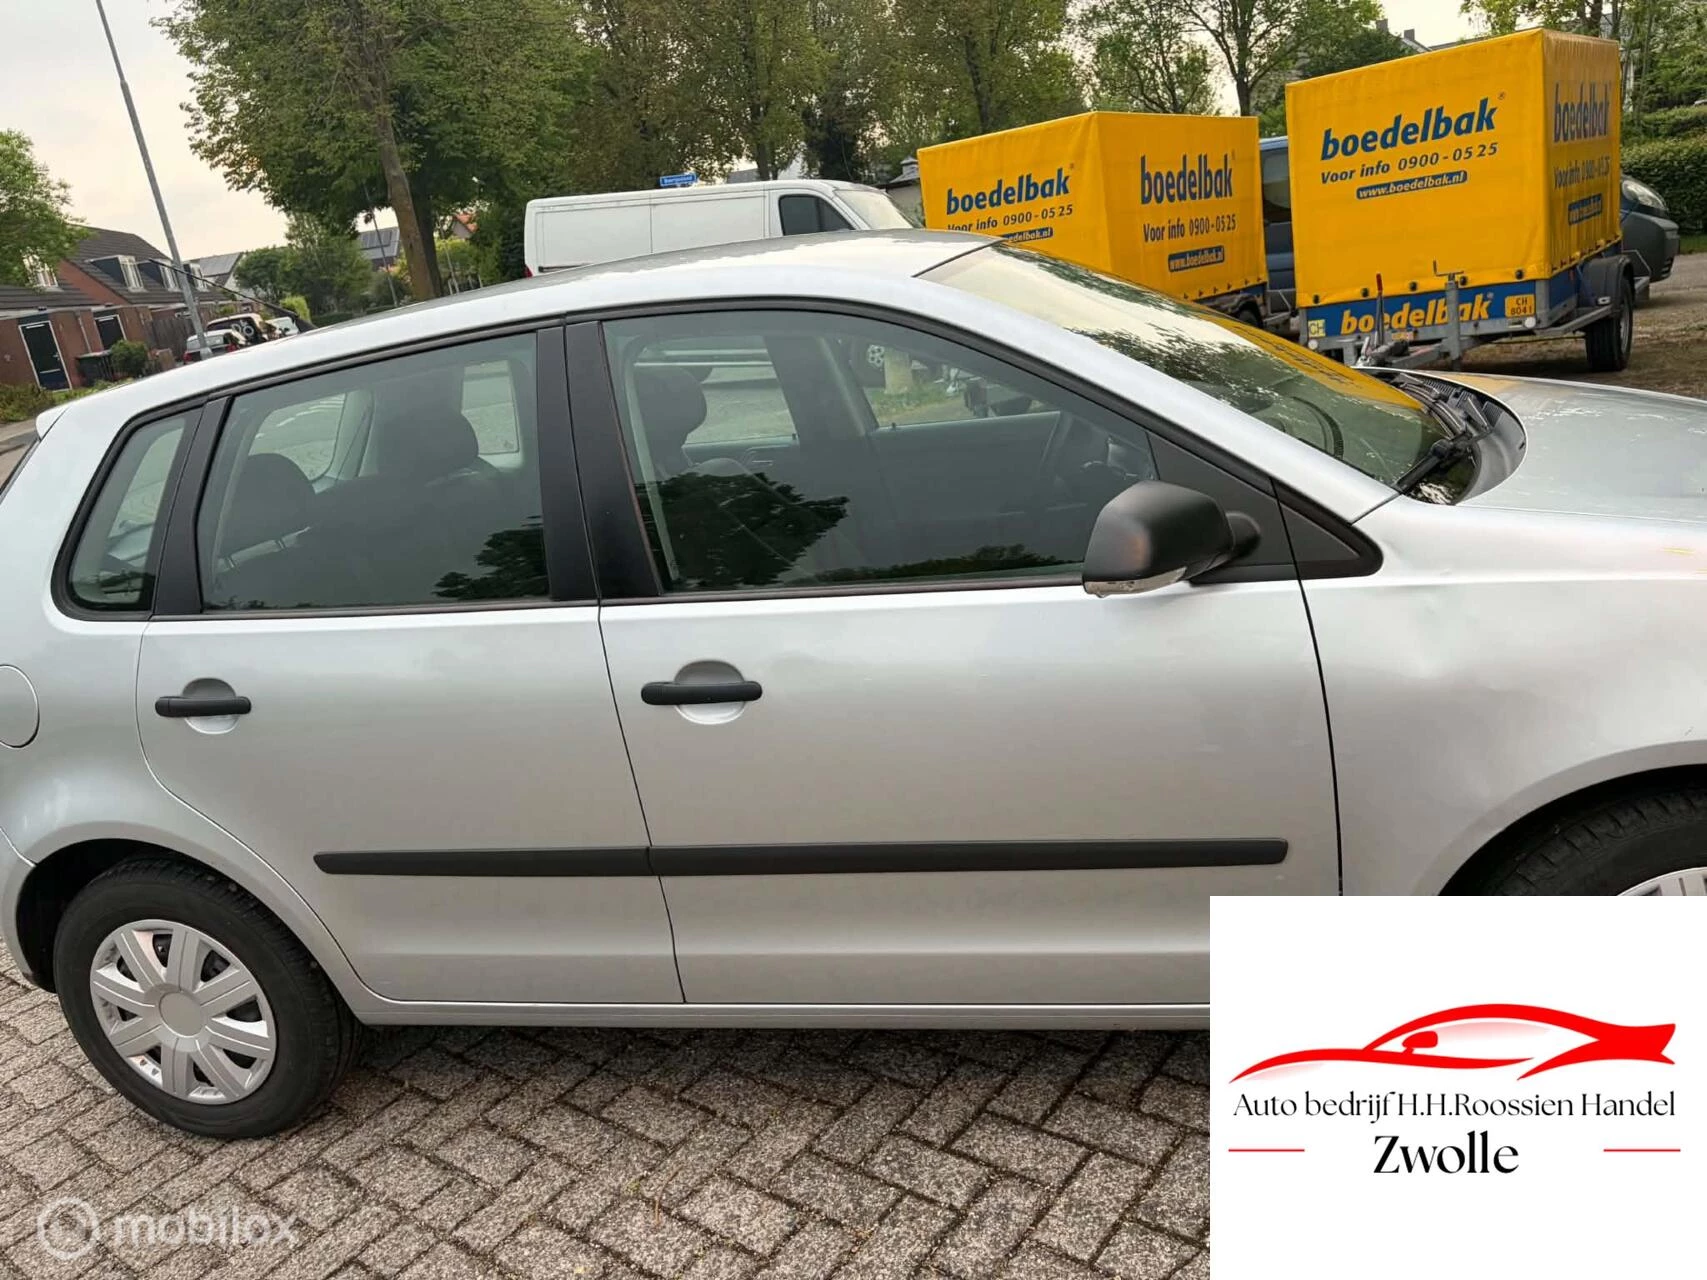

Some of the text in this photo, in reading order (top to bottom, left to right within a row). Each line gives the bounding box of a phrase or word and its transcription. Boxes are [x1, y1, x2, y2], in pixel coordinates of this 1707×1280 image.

[1320, 97, 1498, 161] boedelbak
[1141, 153, 1232, 204] boedelbak
[1321, 168, 1356, 184] Voor
[1360, 160, 1390, 178] info
[1358, 172, 1465, 198] www.boedelbak.nl
[946, 167, 1070, 215] boedelbak
[976, 216, 998, 231] info
[1008, 228, 1051, 241] edelbak.nl
[1143, 223, 1165, 243] Voor
[1168, 217, 1185, 240] info
[1516, 297, 1528, 306] CH
